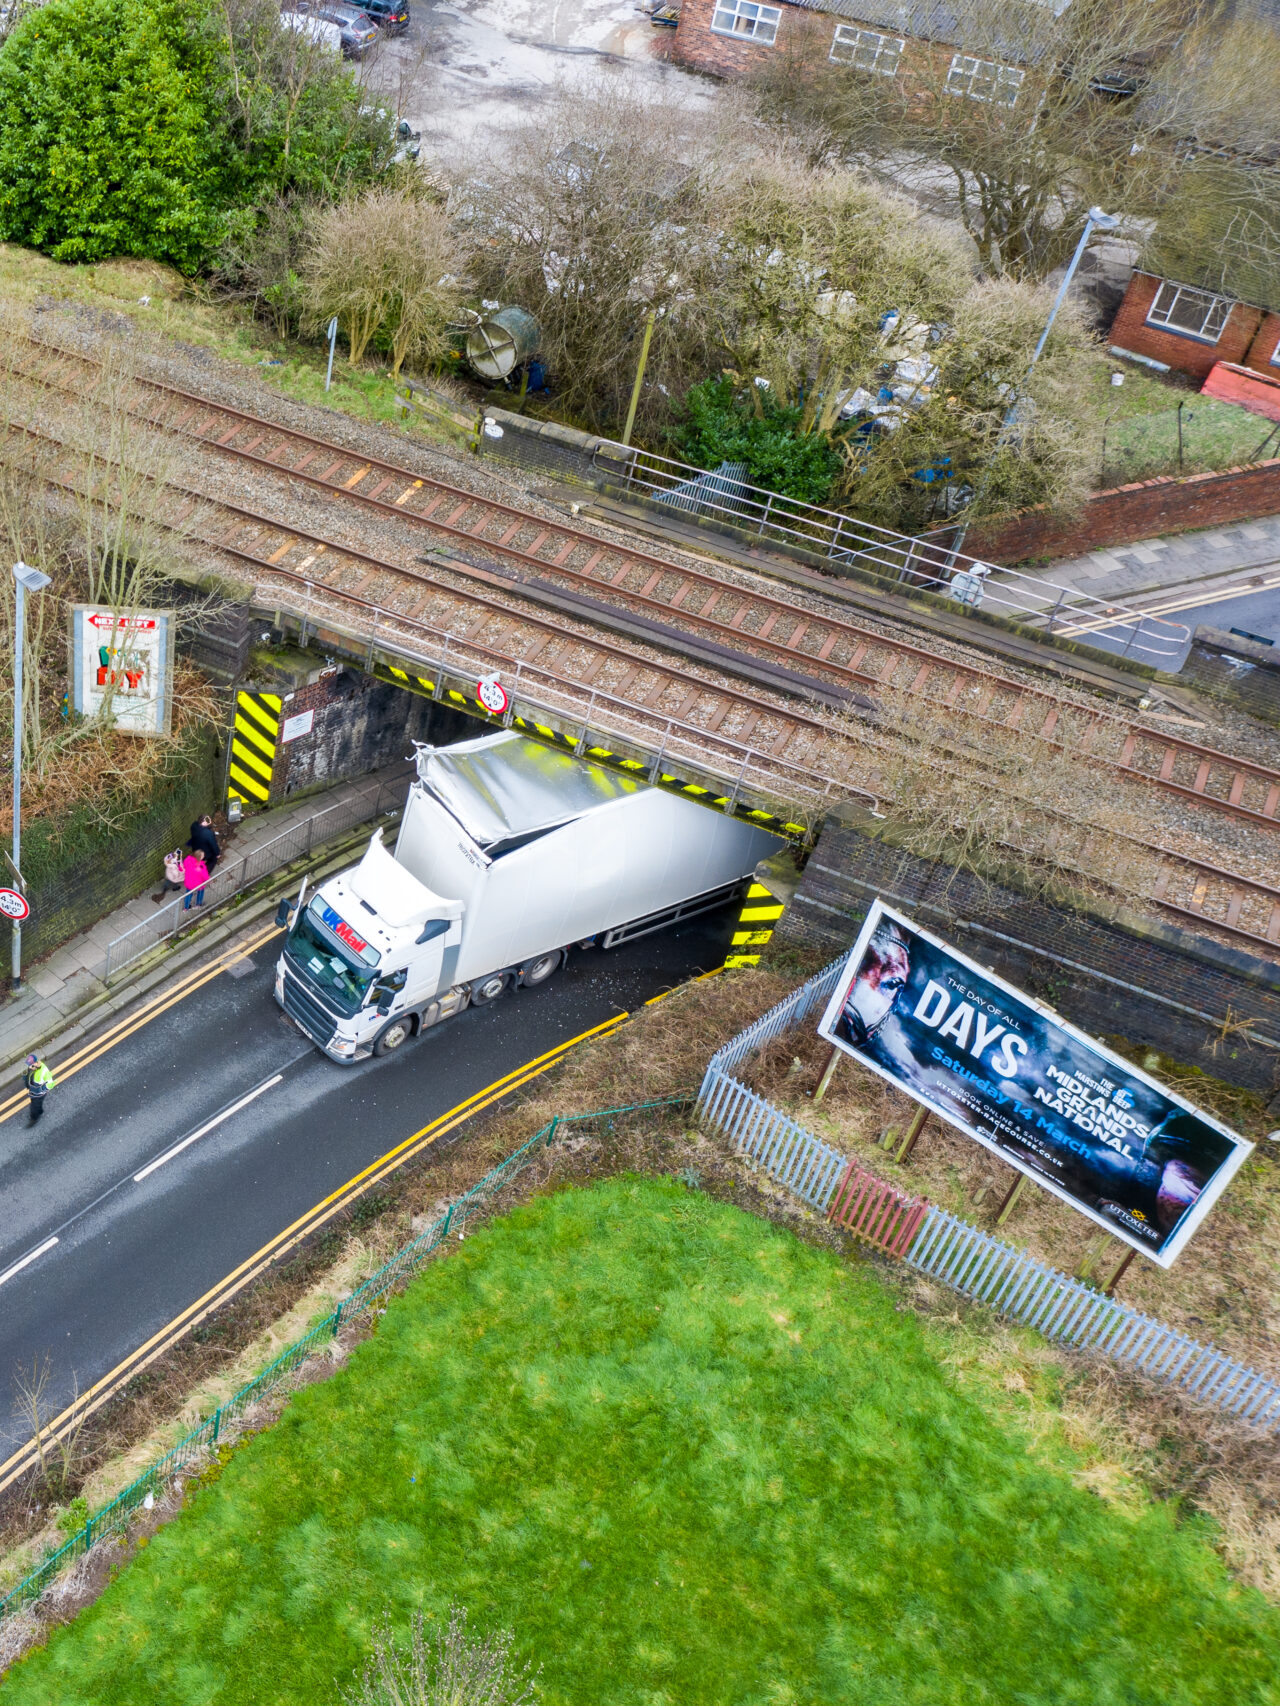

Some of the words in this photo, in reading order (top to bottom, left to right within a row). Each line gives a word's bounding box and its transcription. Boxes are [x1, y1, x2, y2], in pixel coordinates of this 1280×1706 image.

[912, 979, 1029, 1078] DAYS
[946, 976, 968, 994] THE
[966, 990, 987, 1007] DAY
[986, 1004, 1003, 1016] OF
[1001, 1014, 1022, 1031] ALL
[930, 1046, 1011, 1105] Saturday
[1012, 1100, 1033, 1121] 14
[1036, 1116, 1093, 1160] March
[958, 1087, 982, 1106] BOOK
[983, 1104, 1014, 1128] ONLINE
[1033, 1086, 1134, 1160] NATIONAL
[1046, 1064, 1151, 1138] MIDLANDS
[1056, 1086, 1127, 1138] GRAND
[1108, 1202, 1160, 1240] UTTOXETER
